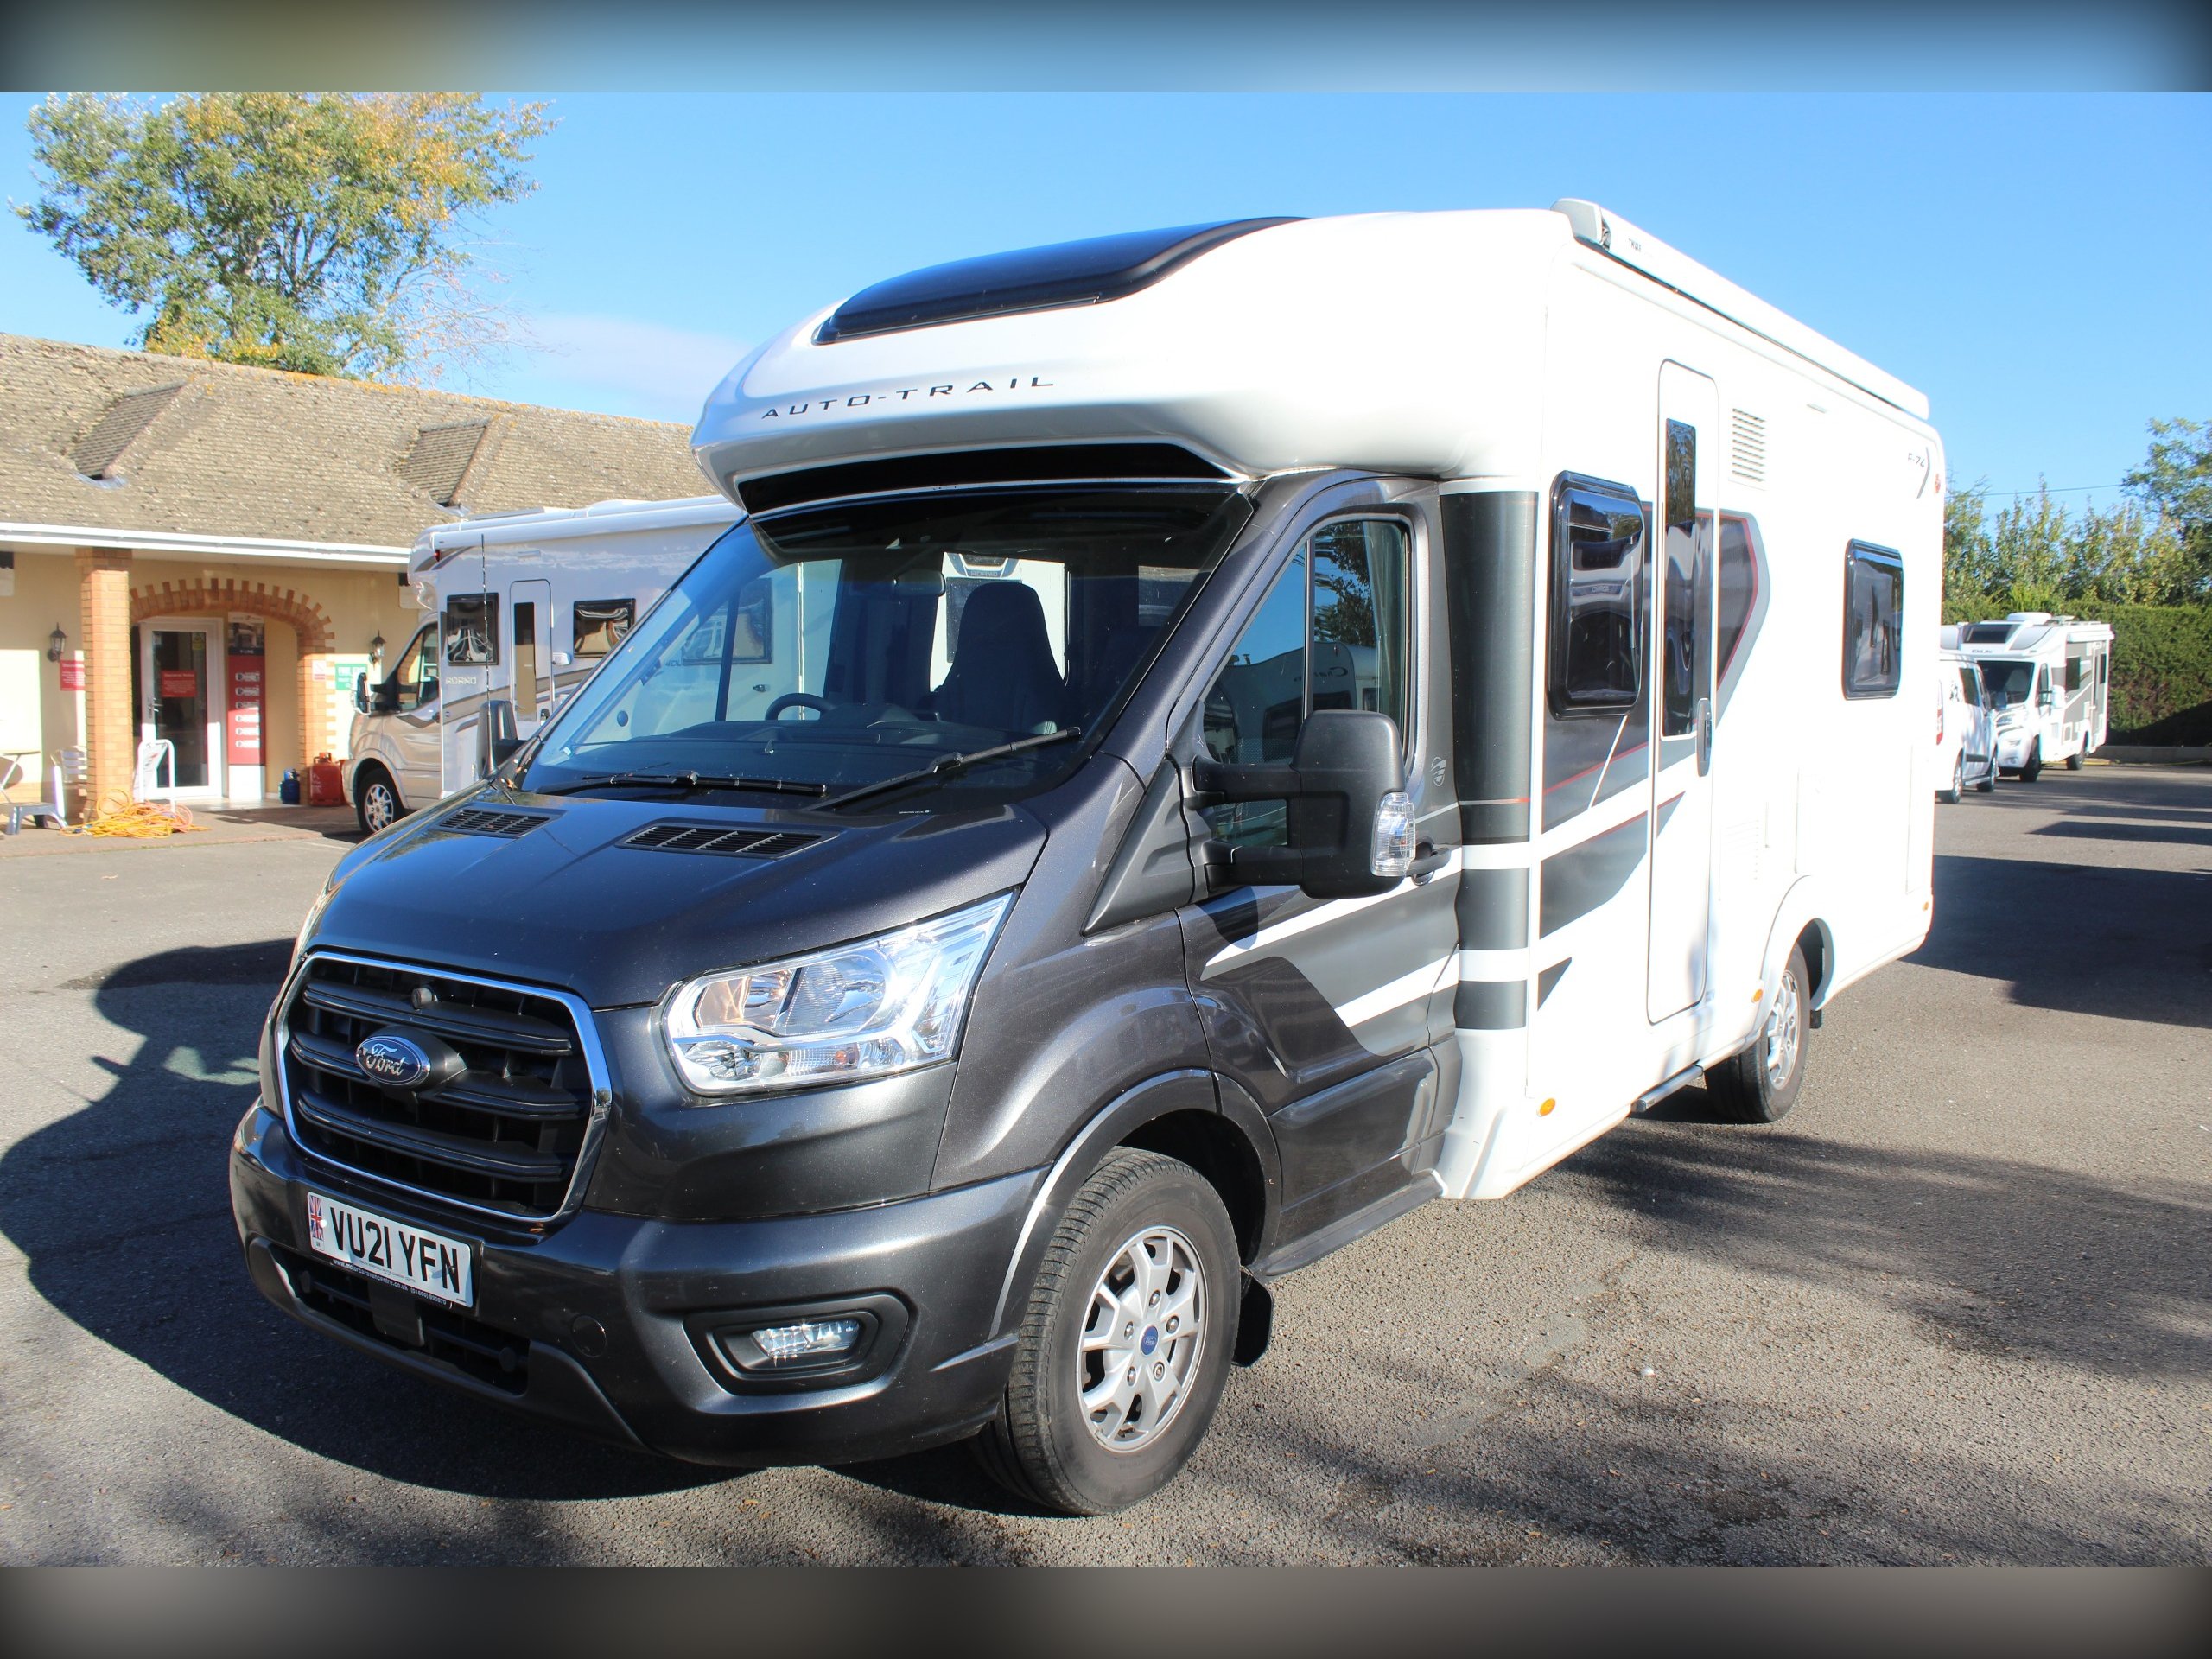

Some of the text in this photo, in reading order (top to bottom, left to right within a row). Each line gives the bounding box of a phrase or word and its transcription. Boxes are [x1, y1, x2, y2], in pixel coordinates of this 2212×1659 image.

[760, 376, 1054, 420] AUTO-TRAIL
[365, 1042, 409, 1077] Ford
[329, 1206, 461, 1294] VU21 YFN
